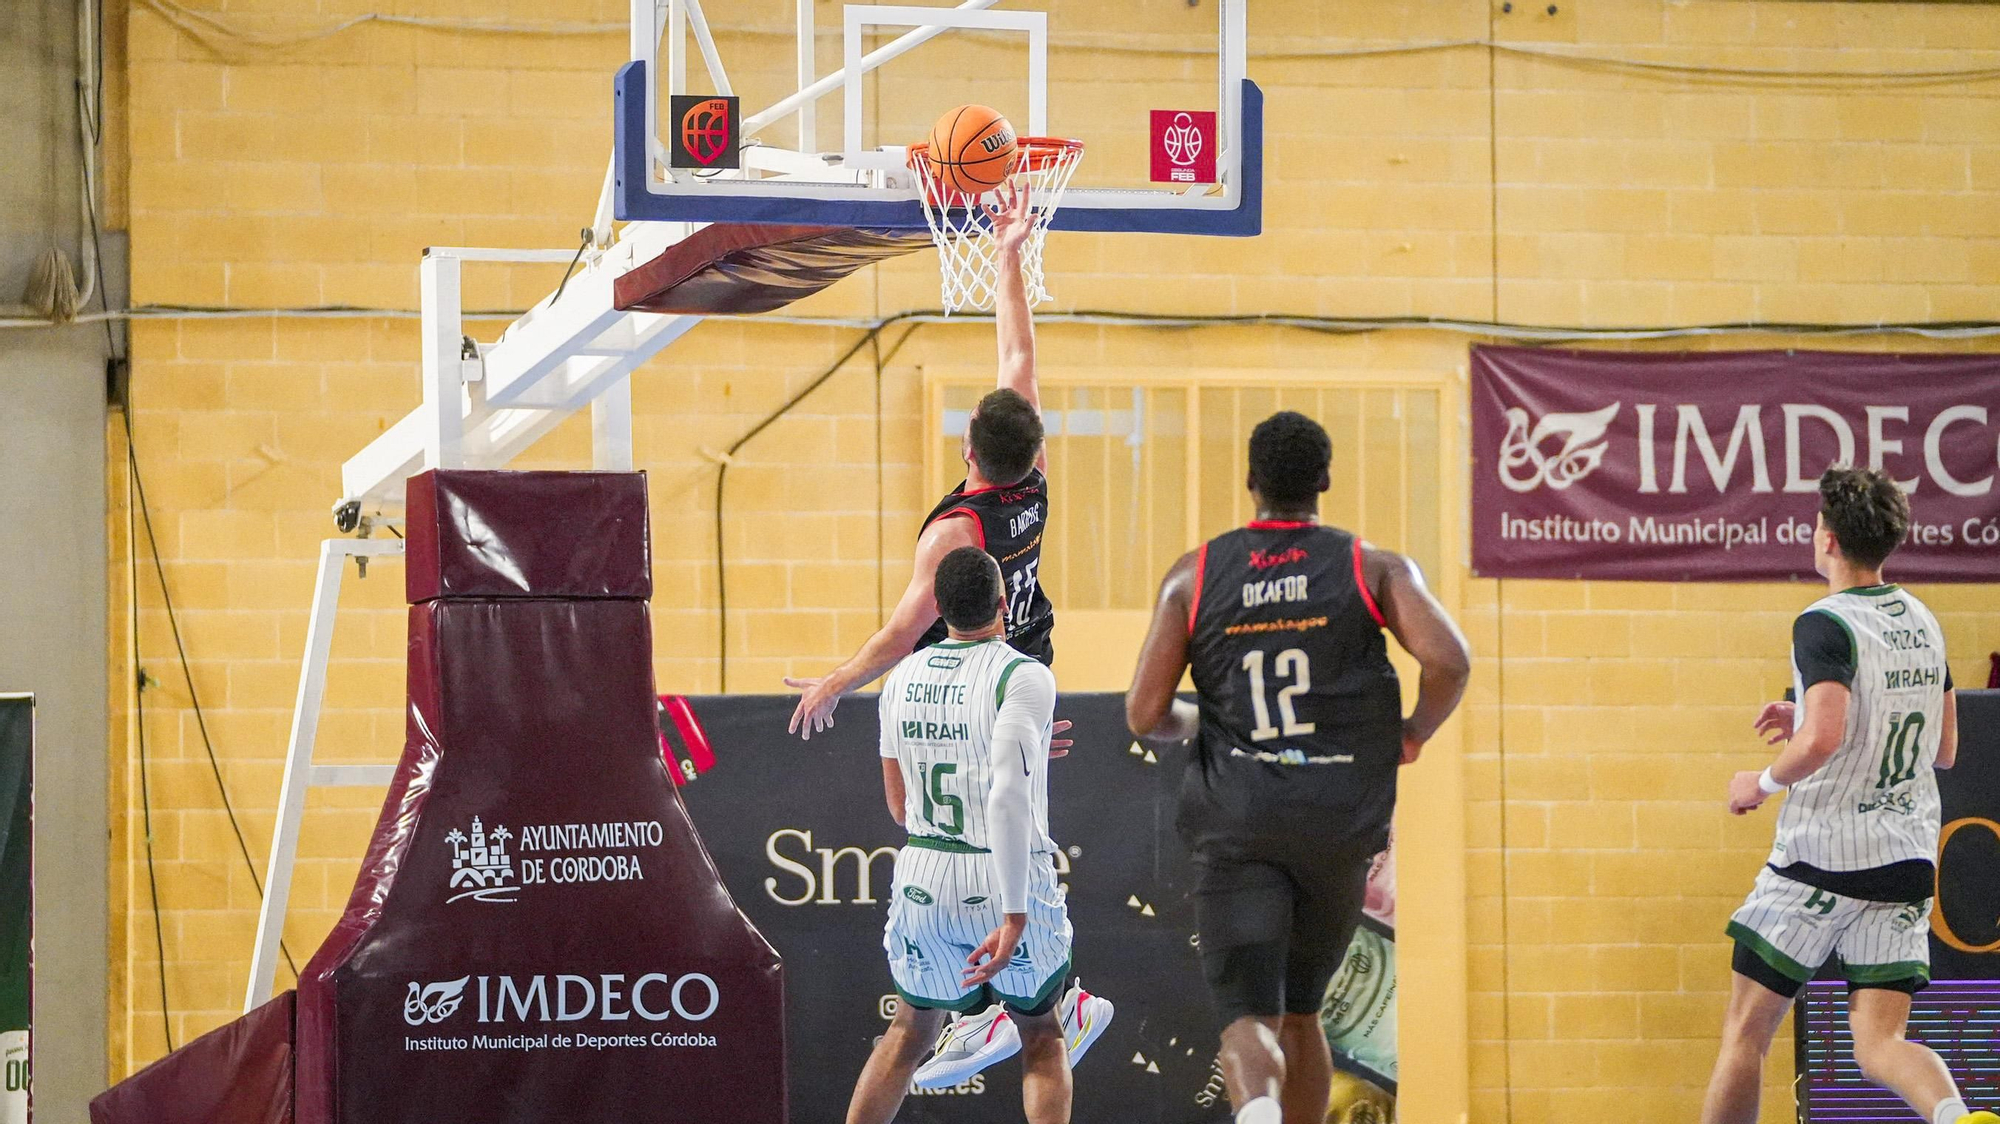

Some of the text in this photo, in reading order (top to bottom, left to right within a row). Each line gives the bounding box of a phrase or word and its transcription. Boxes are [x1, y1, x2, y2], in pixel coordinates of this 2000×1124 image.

[709, 102, 725, 111] FEB
[1170, 172, 1196, 182] FEB
[1635, 403, 2000, 498] IMDEC
[1501, 511, 1621, 543] Instituto
[1628, 516, 1767, 550] Municipal
[1775, 516, 1812, 545] de
[1242, 574, 1309, 608] OKAFOR
[1902, 666, 1939, 688] RAHI
[905, 682, 967, 705] SCHUTTE
[1241, 647, 1316, 742] 12
[926, 721, 969, 741] RAHI
[1875, 711, 1925, 789] 10
[917, 761, 964, 836] 15
[520, 820, 664, 851] AYUNTAMIENTO
[521, 858, 547, 884] DE
[906, 887, 929, 905] Ford
[964, 904, 988, 913] TYSA
[477, 972, 720, 1023] IMDECO
[405, 1031, 718, 1052] Instituto Municipal de Deportes Córdoba
